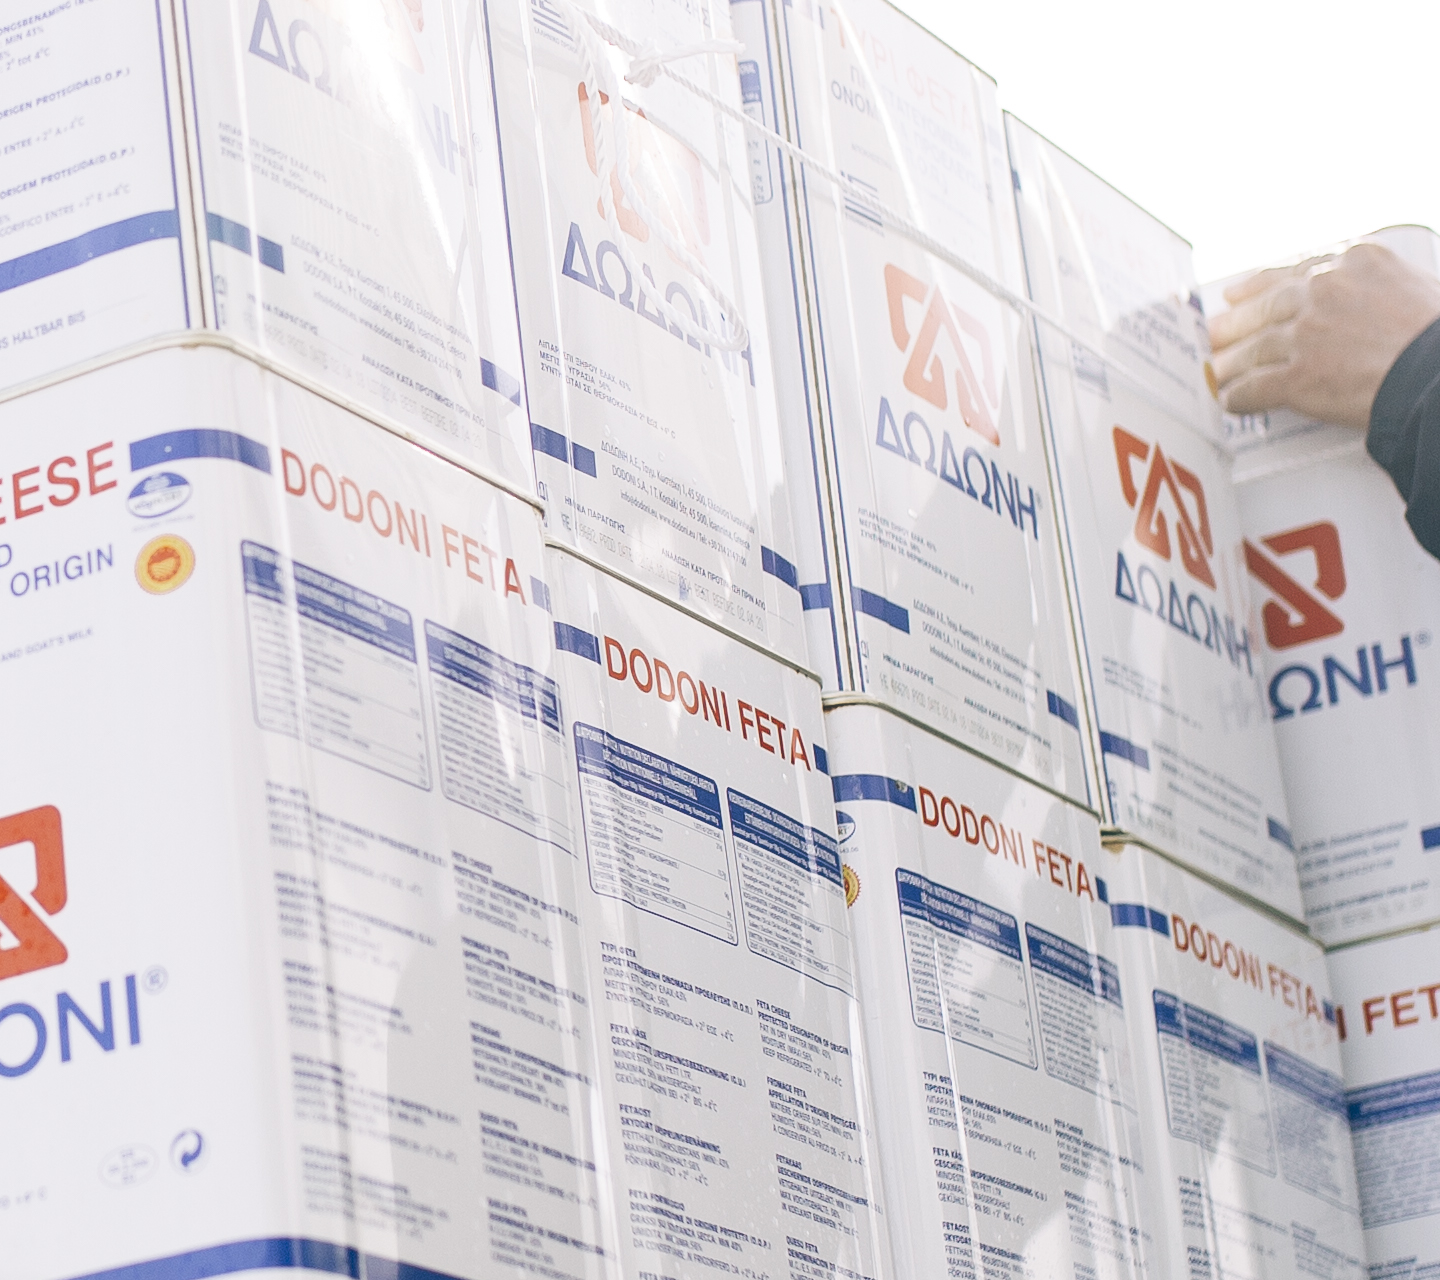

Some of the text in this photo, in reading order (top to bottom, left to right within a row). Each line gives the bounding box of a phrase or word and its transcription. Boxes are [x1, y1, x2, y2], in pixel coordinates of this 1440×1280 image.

[10, 545, 113, 597] ORIGIN
[280, 446, 526, 606] DODONI FETA
[604, 635, 810, 771] DODONI FETA
[918, 785, 1094, 902] DODONI FETA
[1170, 912, 1322, 1026] DODONI FETA
